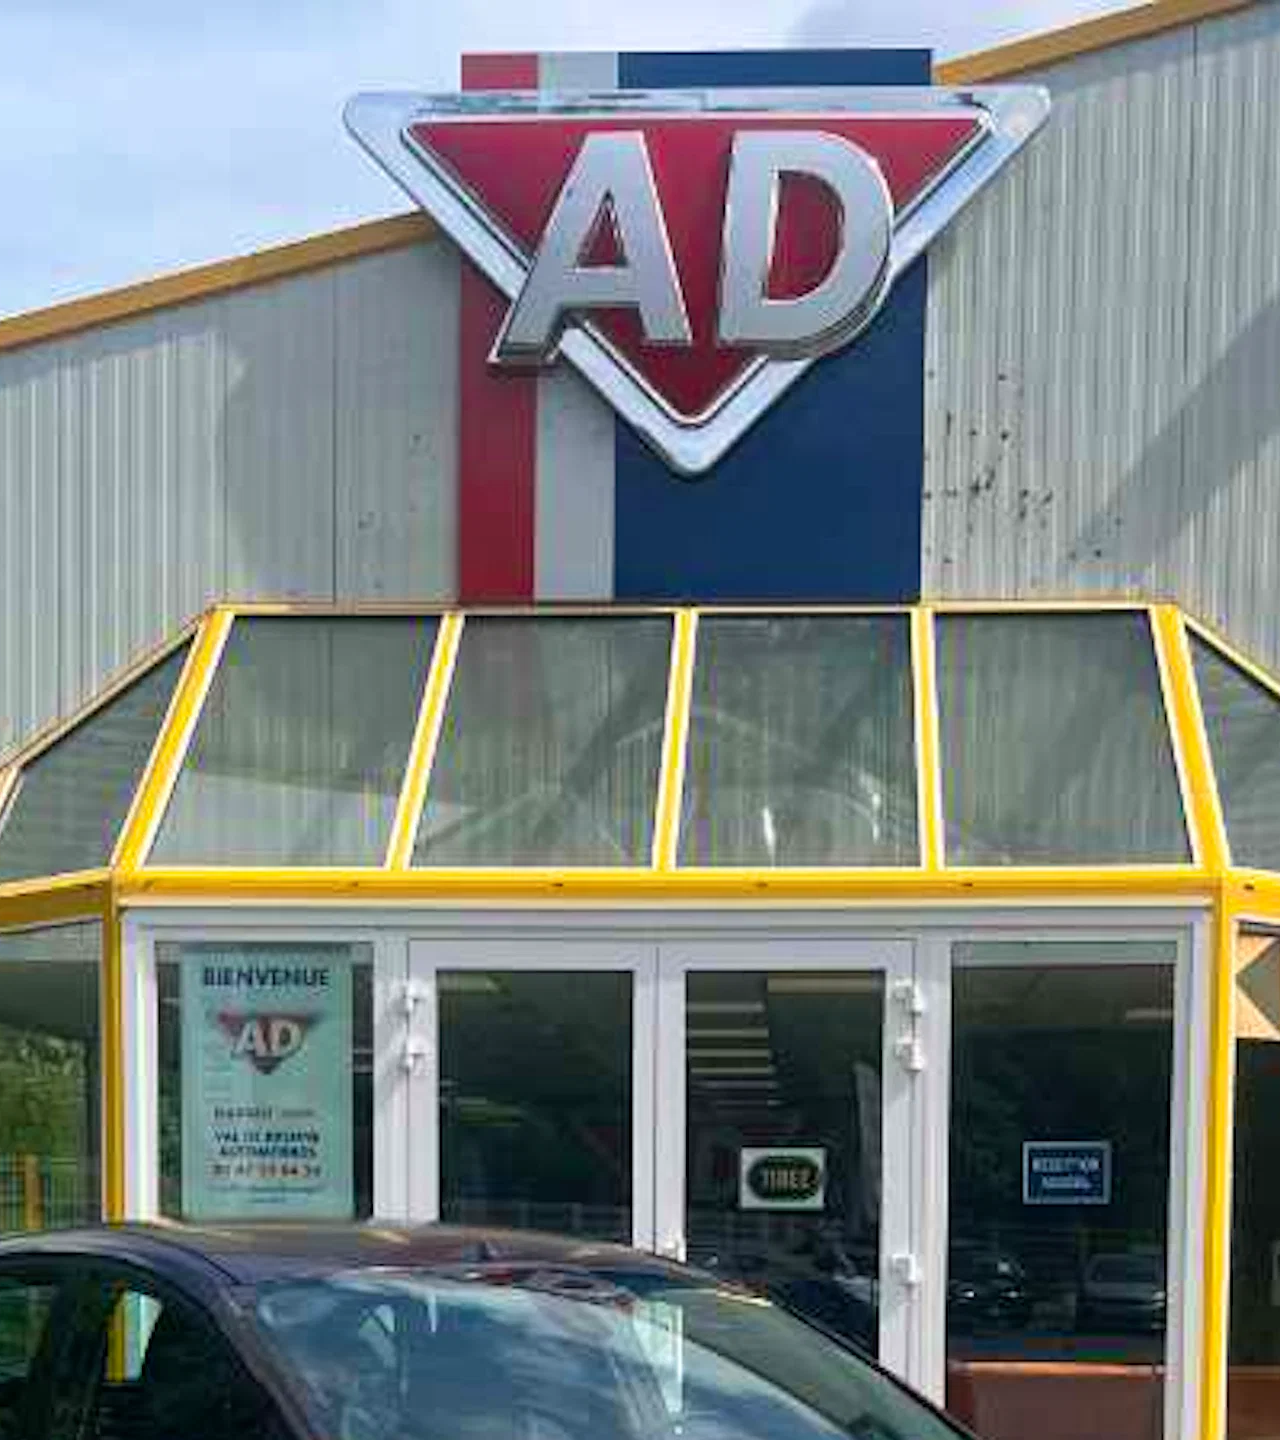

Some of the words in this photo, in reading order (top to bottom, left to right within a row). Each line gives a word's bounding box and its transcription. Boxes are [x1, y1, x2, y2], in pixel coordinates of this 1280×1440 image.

[487, 129, 895, 372] AD
[204, 965, 329, 987] BIENVENUE
[234, 1019, 303, 1058] AD
